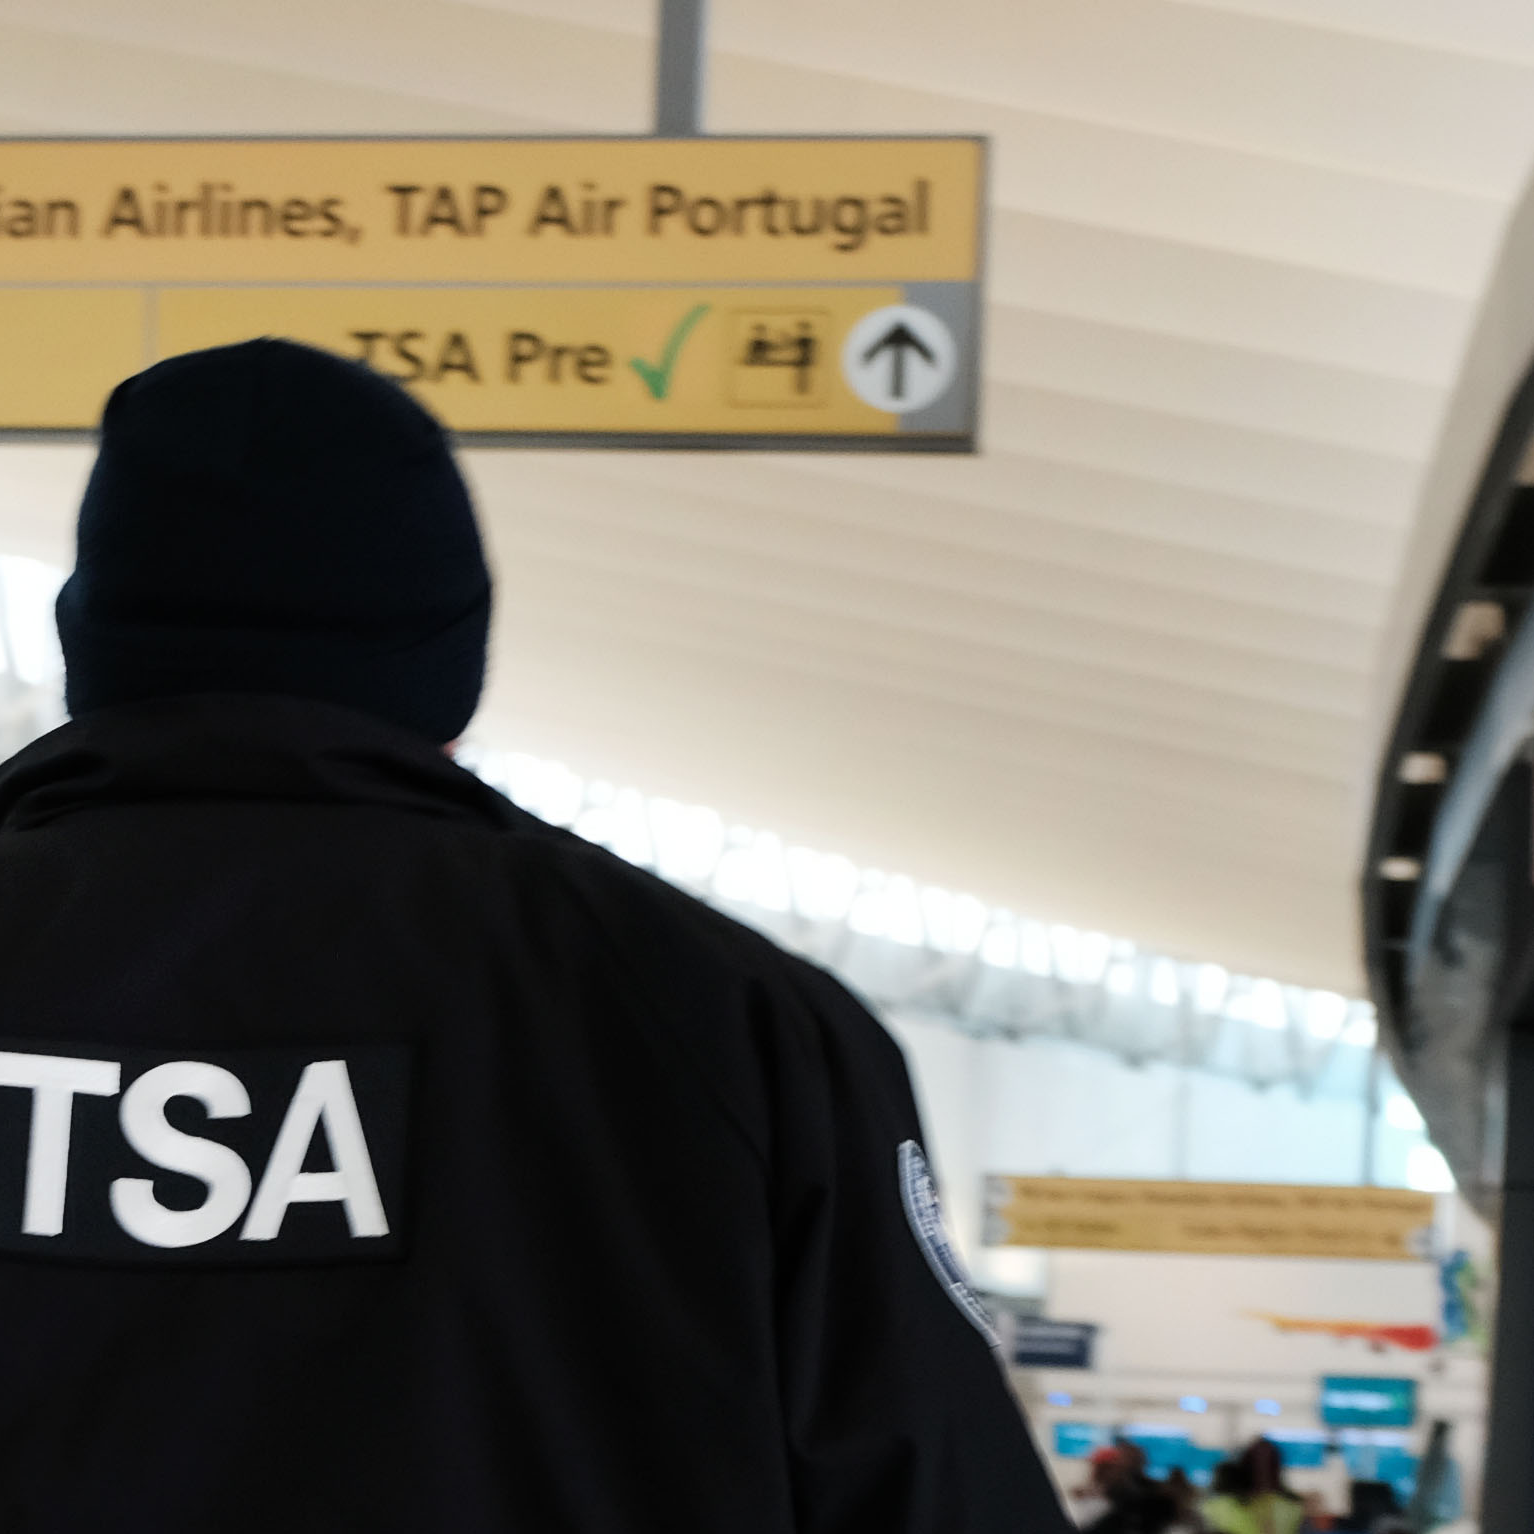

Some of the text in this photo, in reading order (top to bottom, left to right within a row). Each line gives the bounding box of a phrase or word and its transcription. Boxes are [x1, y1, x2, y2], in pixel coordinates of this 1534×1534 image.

[103, 181, 362, 246] Airlines,
[385, 183, 508, 238] TAP
[528, 182, 627, 238] Air
[647, 178, 929, 252] Portugal
[347, 328, 613, 385] TSA Pre
